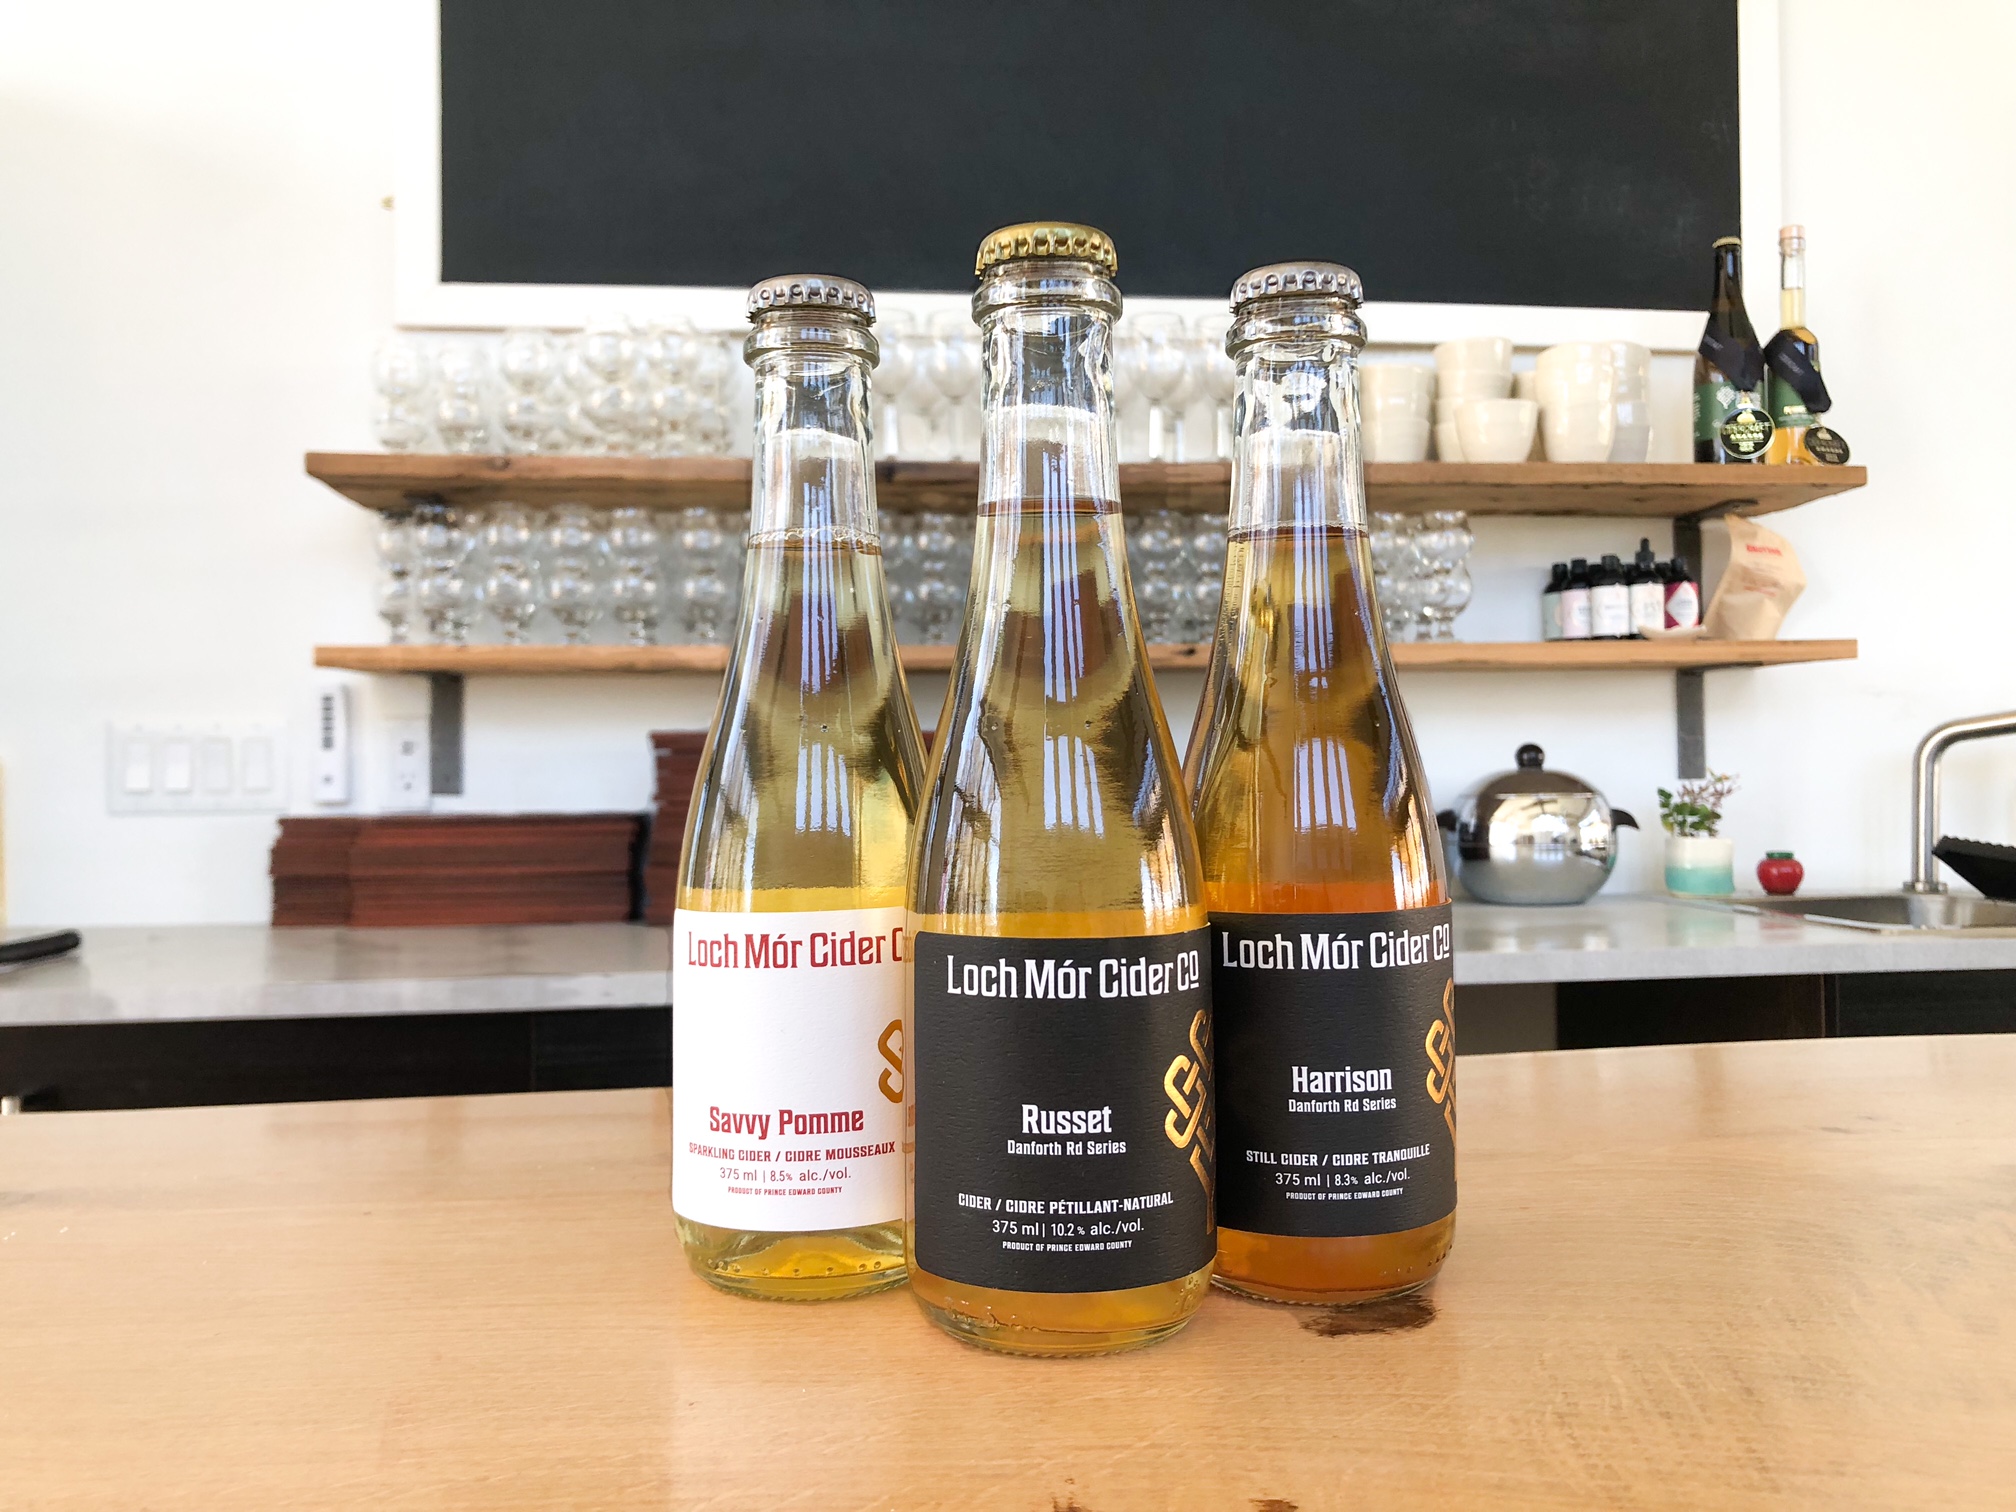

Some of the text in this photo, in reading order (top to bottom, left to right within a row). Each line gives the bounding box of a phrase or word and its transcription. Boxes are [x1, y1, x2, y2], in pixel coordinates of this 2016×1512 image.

[687, 926, 903, 968] Loch Mór Cider C
[1221, 922, 1449, 969] Loch Mór Cider Co
[946, 949, 1199, 998] Loch Mór Cider Co
[1291, 1065, 1392, 1093] Harrison
[1288, 1096, 1396, 1113] Danforth Rd Series
[709, 1105, 863, 1140] Savvy Pomme
[1021, 1103, 1112, 1134] Russet
[689, 1140, 895, 1163] SPARKLING CIDER / CIDRE MOUSSEAUX
[1007, 1139, 1126, 1156] Danforth Rd Series
[1246, 1143, 1430, 1167] STILL CIDER / CIDRE TRANQUILLE
[719, 1166, 739, 1181] 375
[743, 1169, 757, 1182] ml
[769, 1169, 792, 1182] 8.5%
[799, 1166, 851, 1182] alc./vol.
[1275, 1172, 1300, 1186] 375
[1304, 1173, 1320, 1186] ml
[1334, 1173, 1358, 1187] 8.3%
[1363, 1167, 1410, 1184] alc./vol.
[727, 1185, 842, 1196] PRODUCT OF PRINCE EDWARD COUNTY
[1285, 1187, 1403, 1201] PRODUCT OF PRINCE EDWARD COUNTY
[958, 1191, 1173, 1215] CIDER / CIDRE PÉTILLANT-NATURAL
[992, 1219, 1017, 1235] 375
[1021, 1222, 1038, 1236] ml
[1090, 1217, 1144, 1235] alc./vol.
[1002, 1239, 1132, 1252] PRODUCT OF PRINCE EDWARD COUNTY
